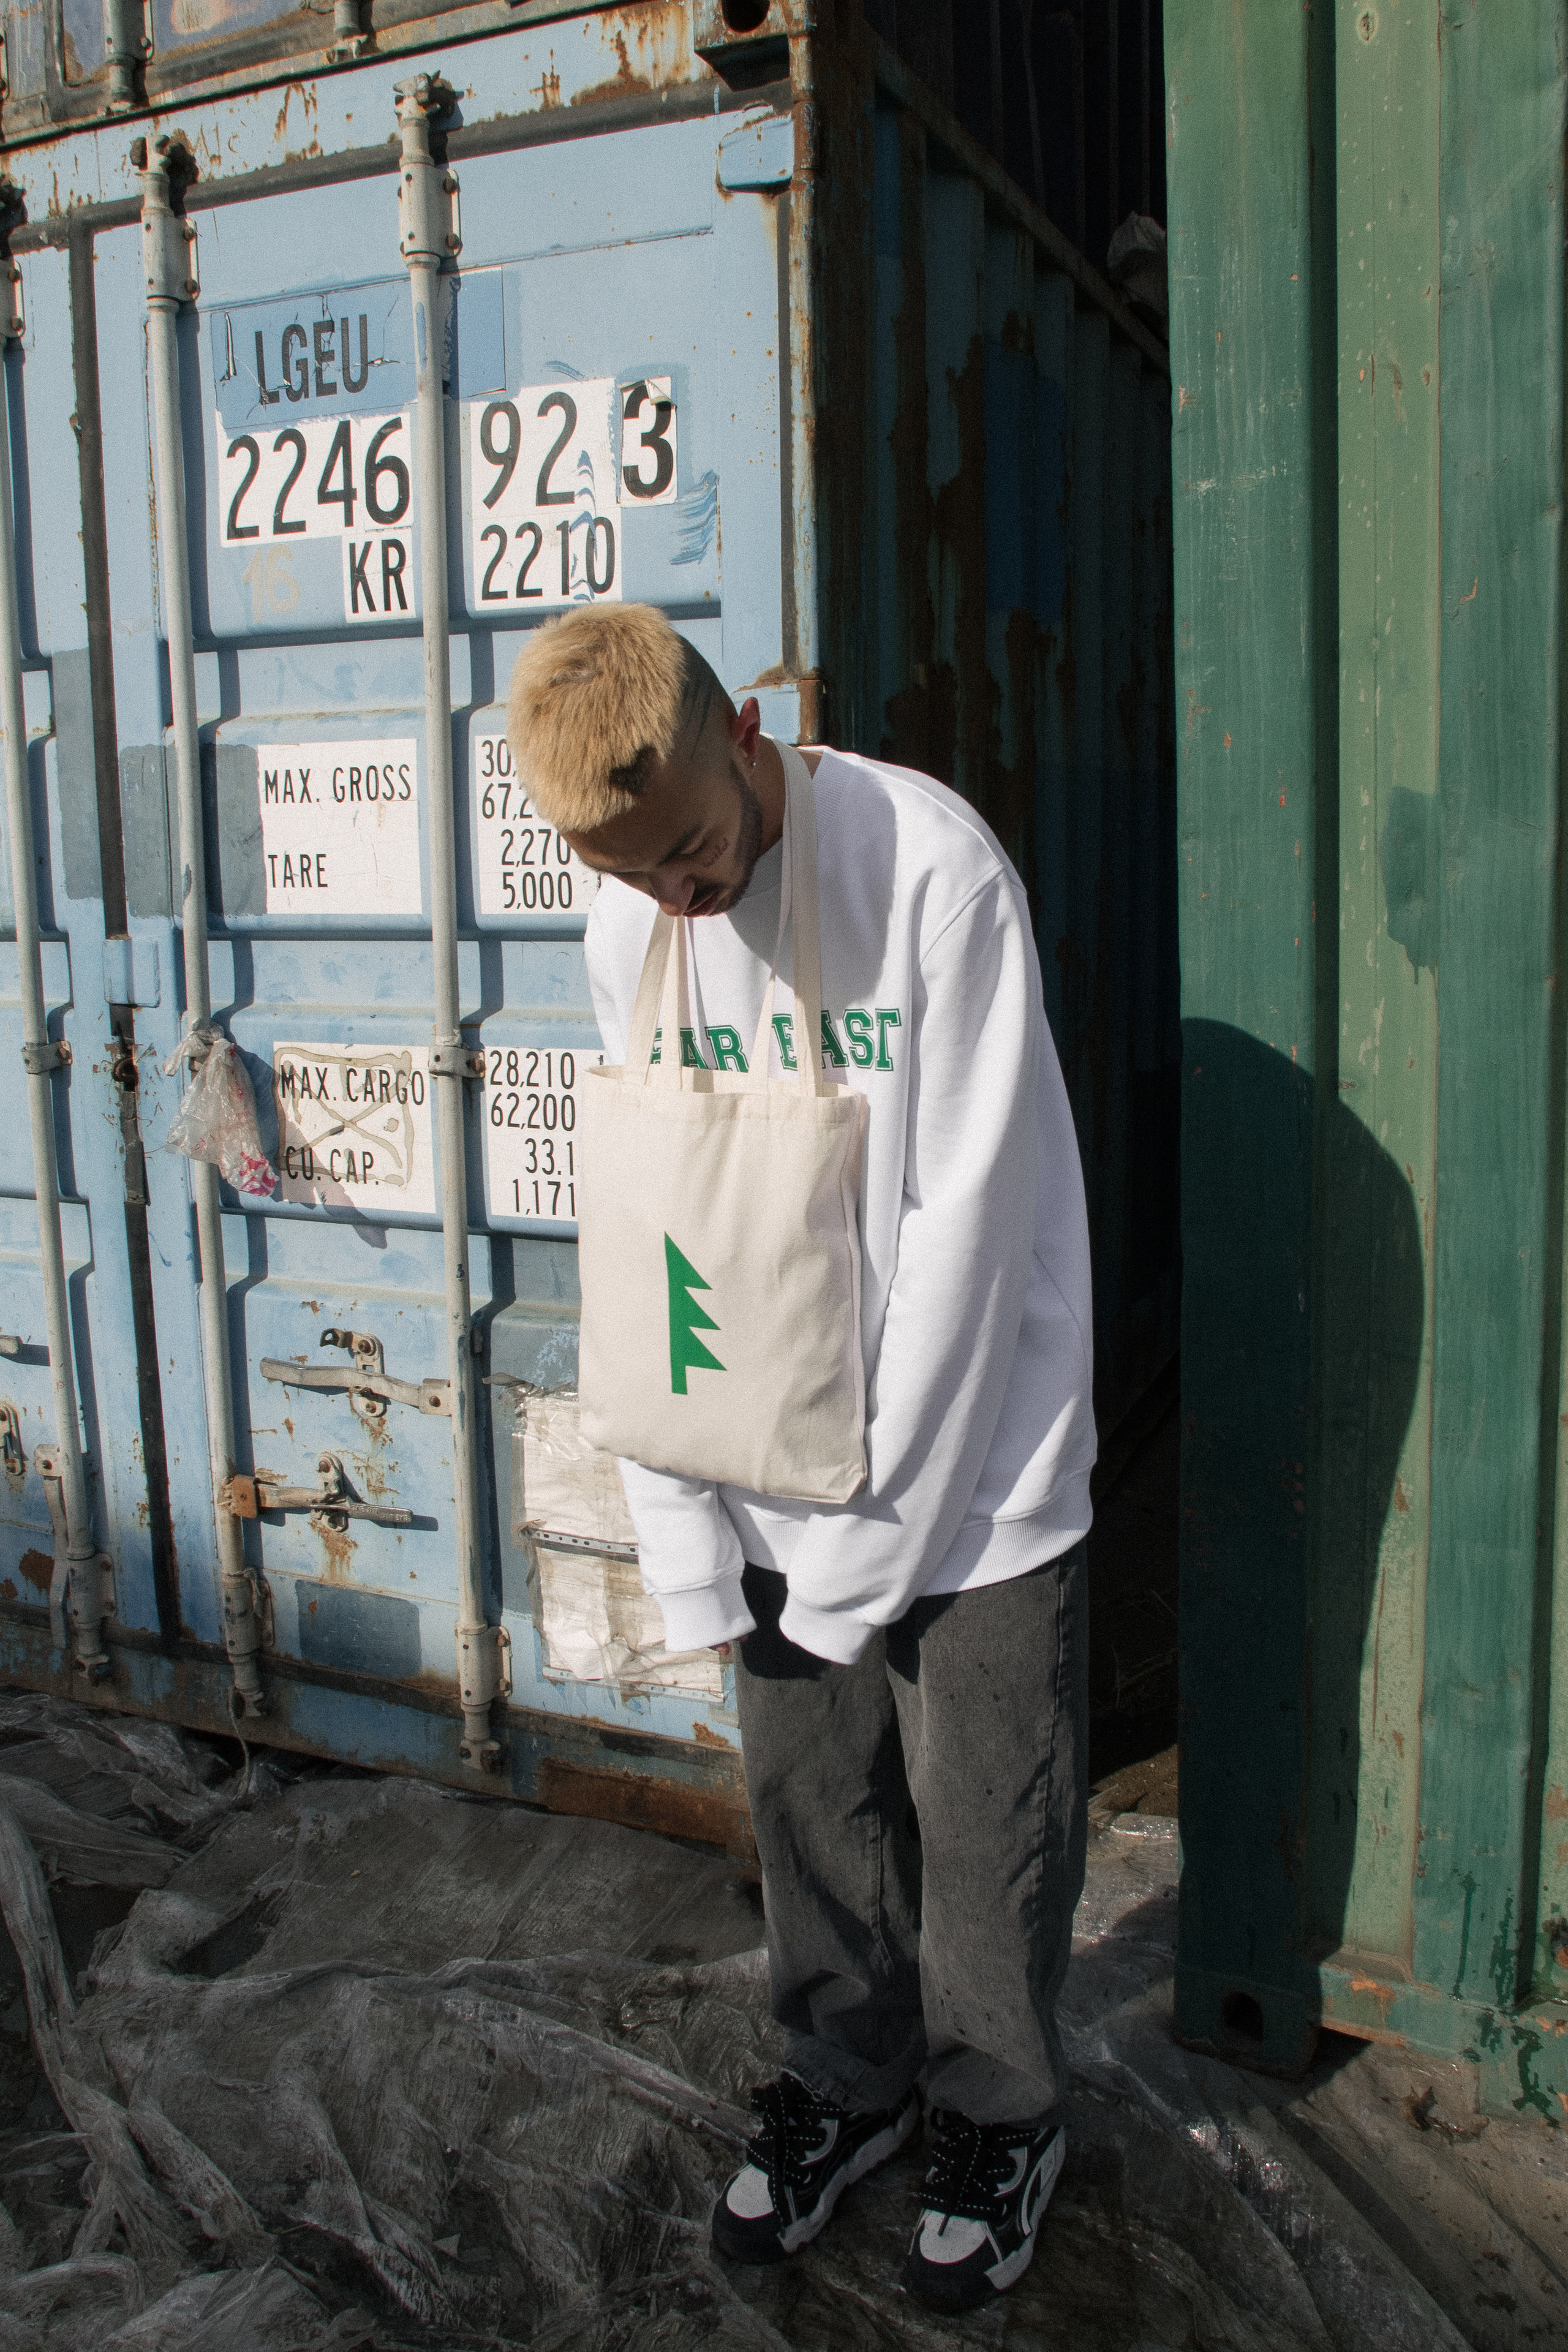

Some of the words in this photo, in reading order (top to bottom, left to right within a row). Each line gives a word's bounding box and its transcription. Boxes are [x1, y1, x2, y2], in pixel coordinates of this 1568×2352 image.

[255, 313, 369, 405] LGEU
[227, 417, 410, 540] 2246
[480, 391, 578, 510] 92
[622, 380, 676, 498] 3
[349, 538, 408, 614] KR
[481, 516, 615, 600] 2210
[265, 768, 320, 803] MAX.
[333, 764, 411, 803] GROSS
[501, 828, 571, 867] 2,270
[268, 853, 328, 888] TARE
[502, 871, 572, 910] 5,000
[772, 1008, 902, 1071] EAST
[280, 1065, 337, 1101] MAX.
[347, 1068, 424, 1106] CARGO
[490, 1050, 575, 1090] 28,210
[491, 1092, 576, 1132] 62,200
[285, 1145, 321, 1182] CU.
[330, 1148, 379, 1185] CAP.
[525, 1137, 575, 1176] 33.1
[513, 1178, 576, 1217] 1,171
